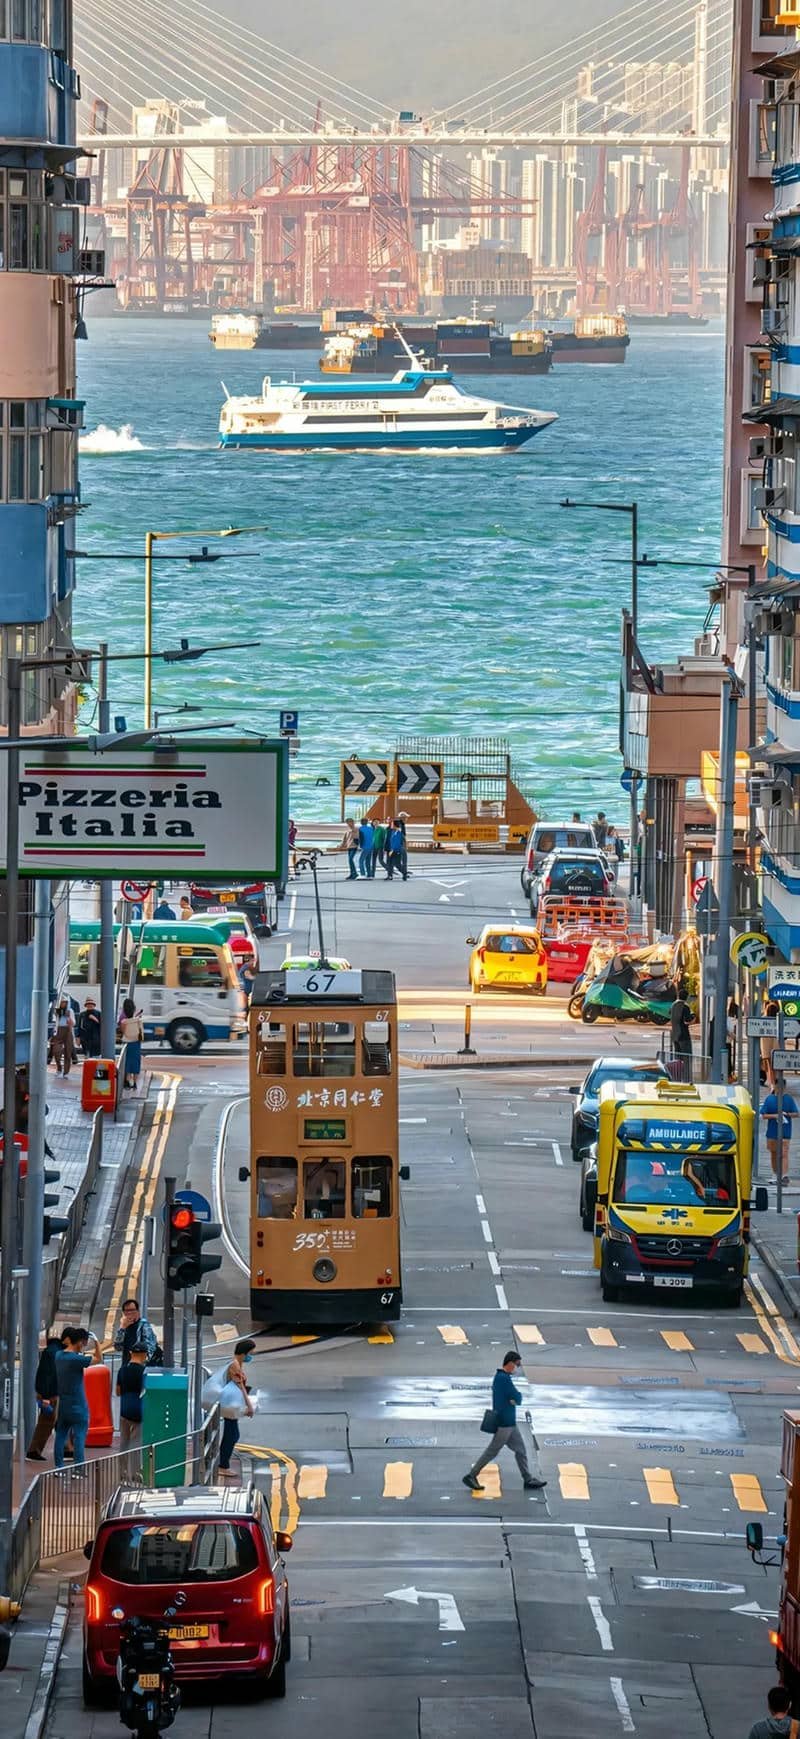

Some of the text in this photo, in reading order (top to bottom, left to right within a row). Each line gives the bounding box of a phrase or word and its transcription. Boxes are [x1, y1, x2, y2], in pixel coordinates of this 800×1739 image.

[283, 713, 294, 729] P
[18, 781, 223, 808] Pizzeria
[35, 812, 195, 837] Italia
[305, 974, 337, 993] 67
[258, 1011, 272, 1023] 67
[375, 1010, 390, 1022] 67
[296, 1088, 384, 1109] 北京同仁堂
[648, 1127, 706, 1141] AMBULANCE
[380, 1292, 394, 1305] 67
